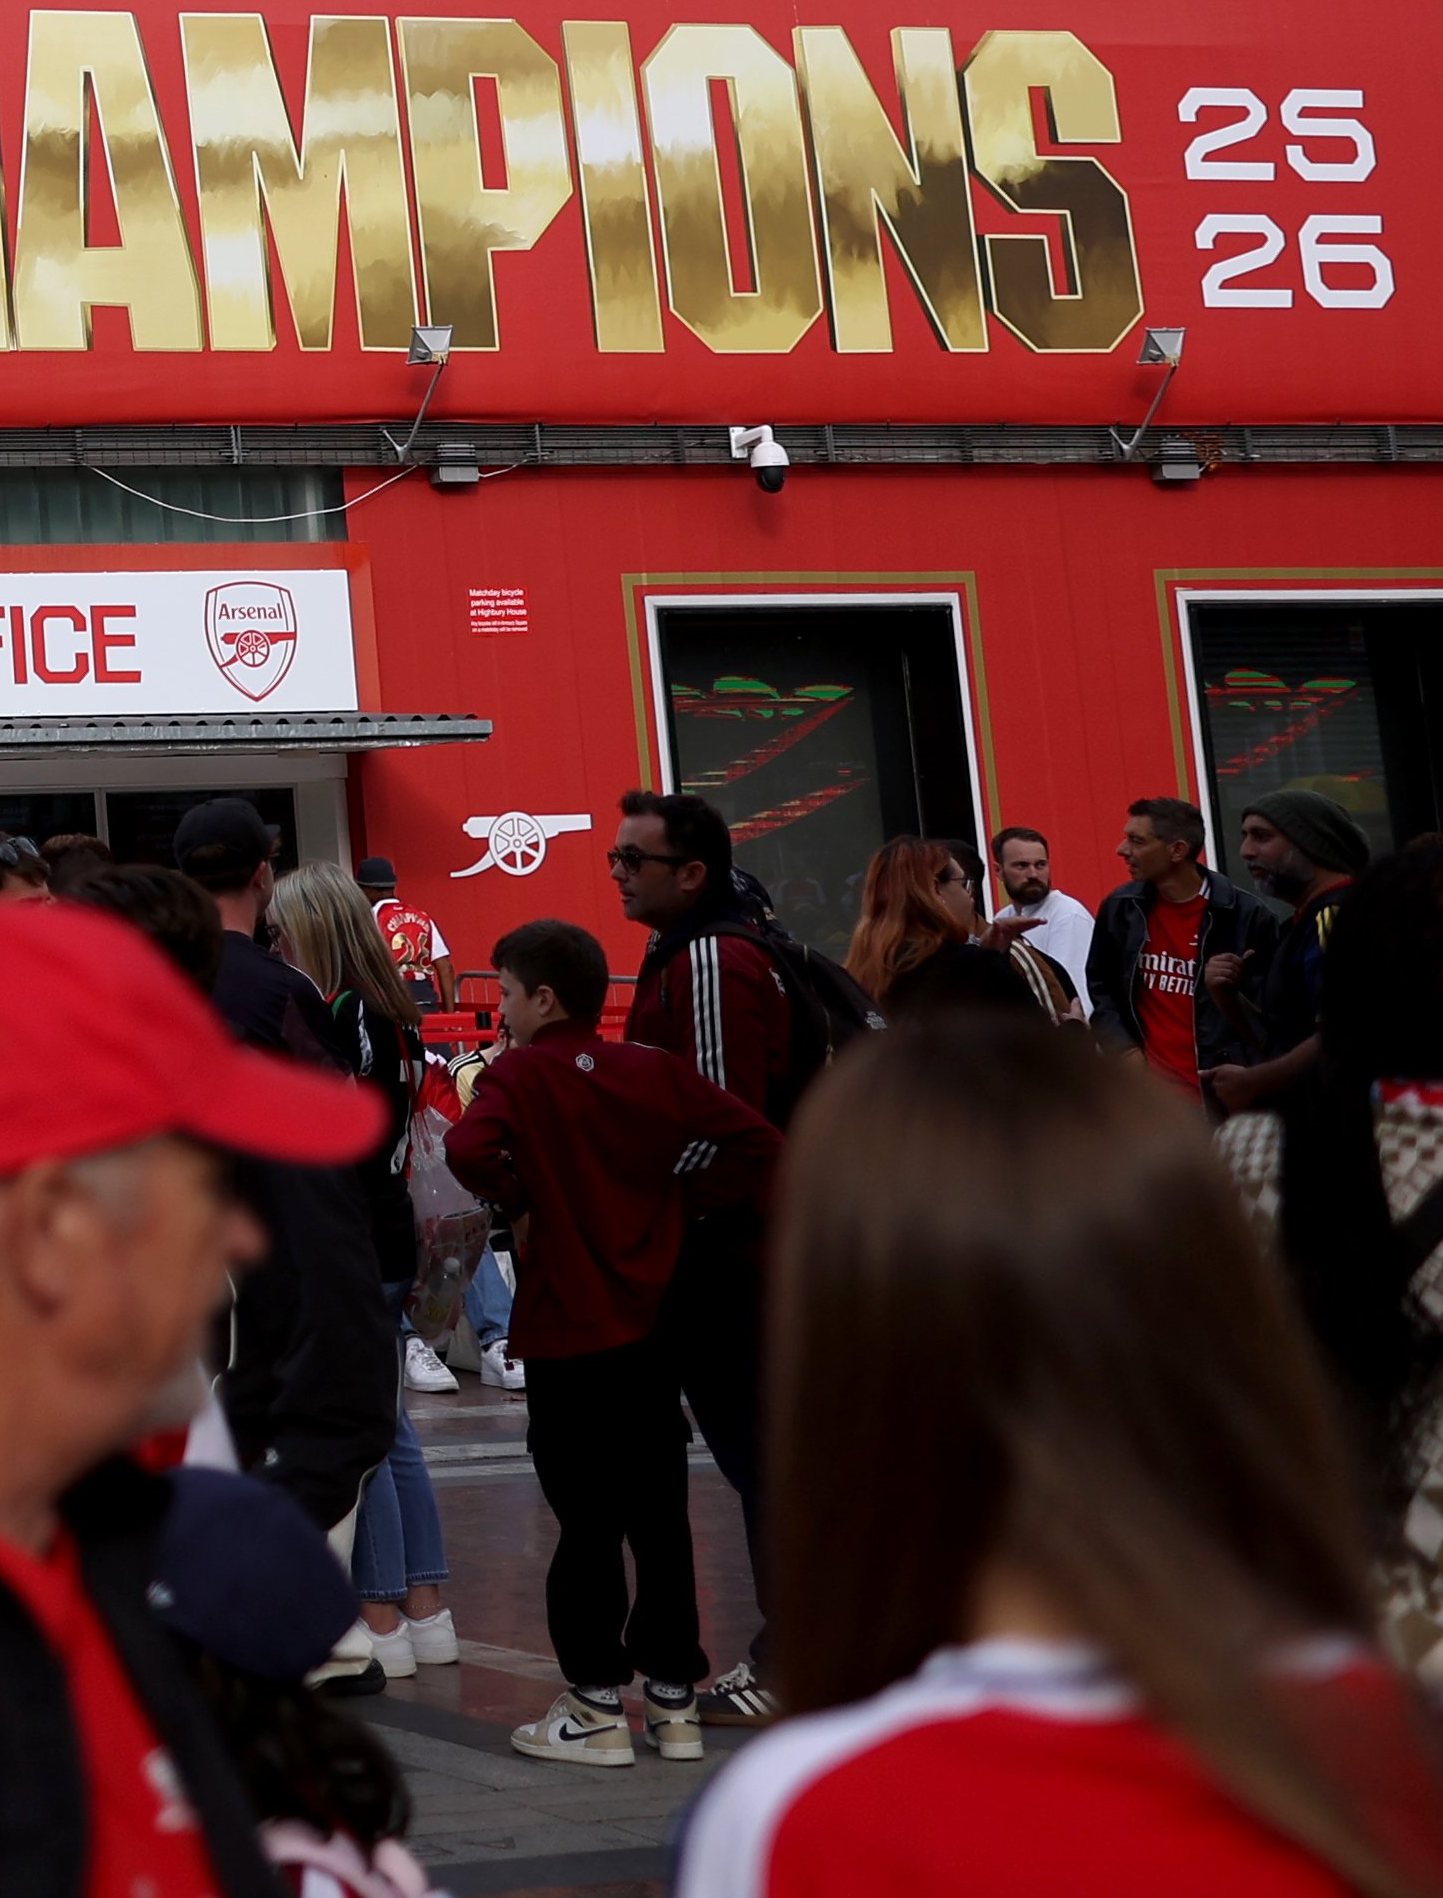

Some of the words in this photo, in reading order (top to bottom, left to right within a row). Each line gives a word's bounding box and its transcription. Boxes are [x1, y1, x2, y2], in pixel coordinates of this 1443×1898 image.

[1177, 87, 1377, 183] 25
[1194, 213, 1396, 309] 26
[218, 603, 283, 620] Arsenal
[1158, 974, 1196, 997] BETTE
